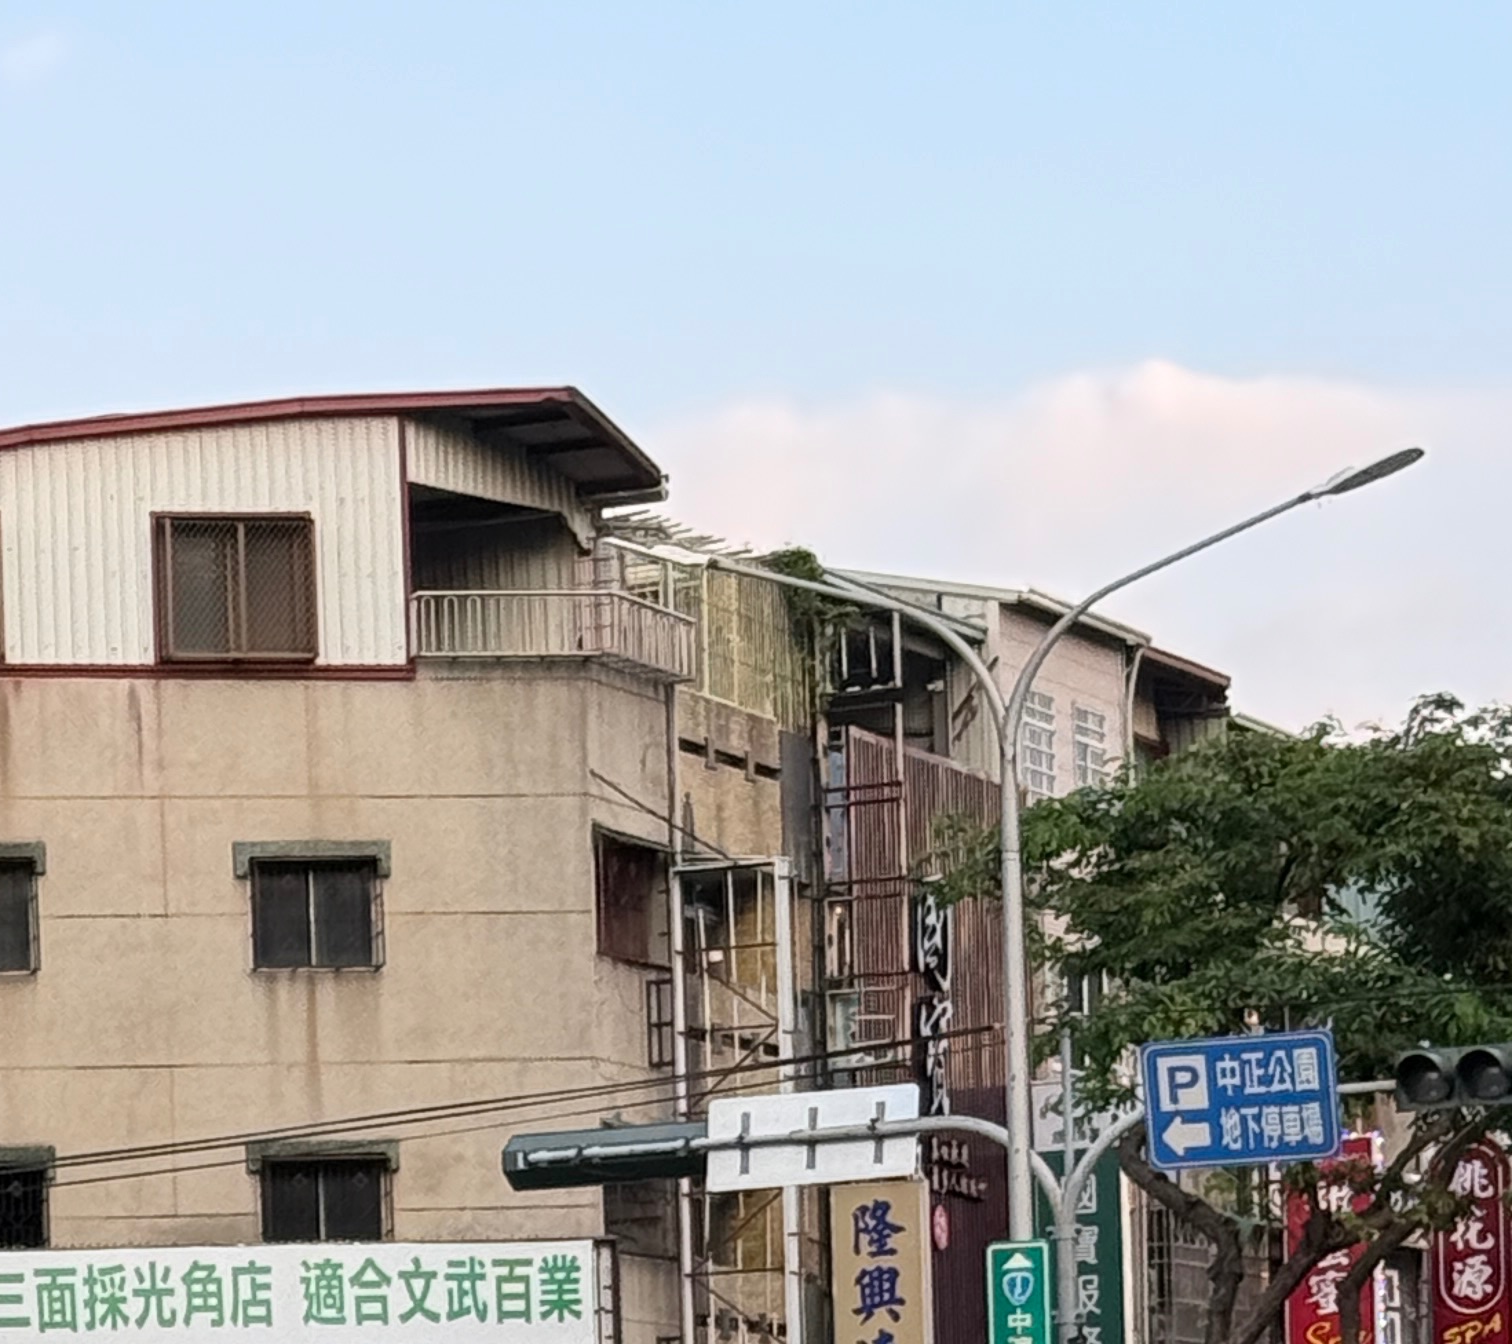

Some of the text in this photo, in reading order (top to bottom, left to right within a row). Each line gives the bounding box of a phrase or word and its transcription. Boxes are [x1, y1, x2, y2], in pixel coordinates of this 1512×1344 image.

[1216, 1047, 1320, 1097] 中正公園
[300, 1256, 583, 1327] 適合文武百業
